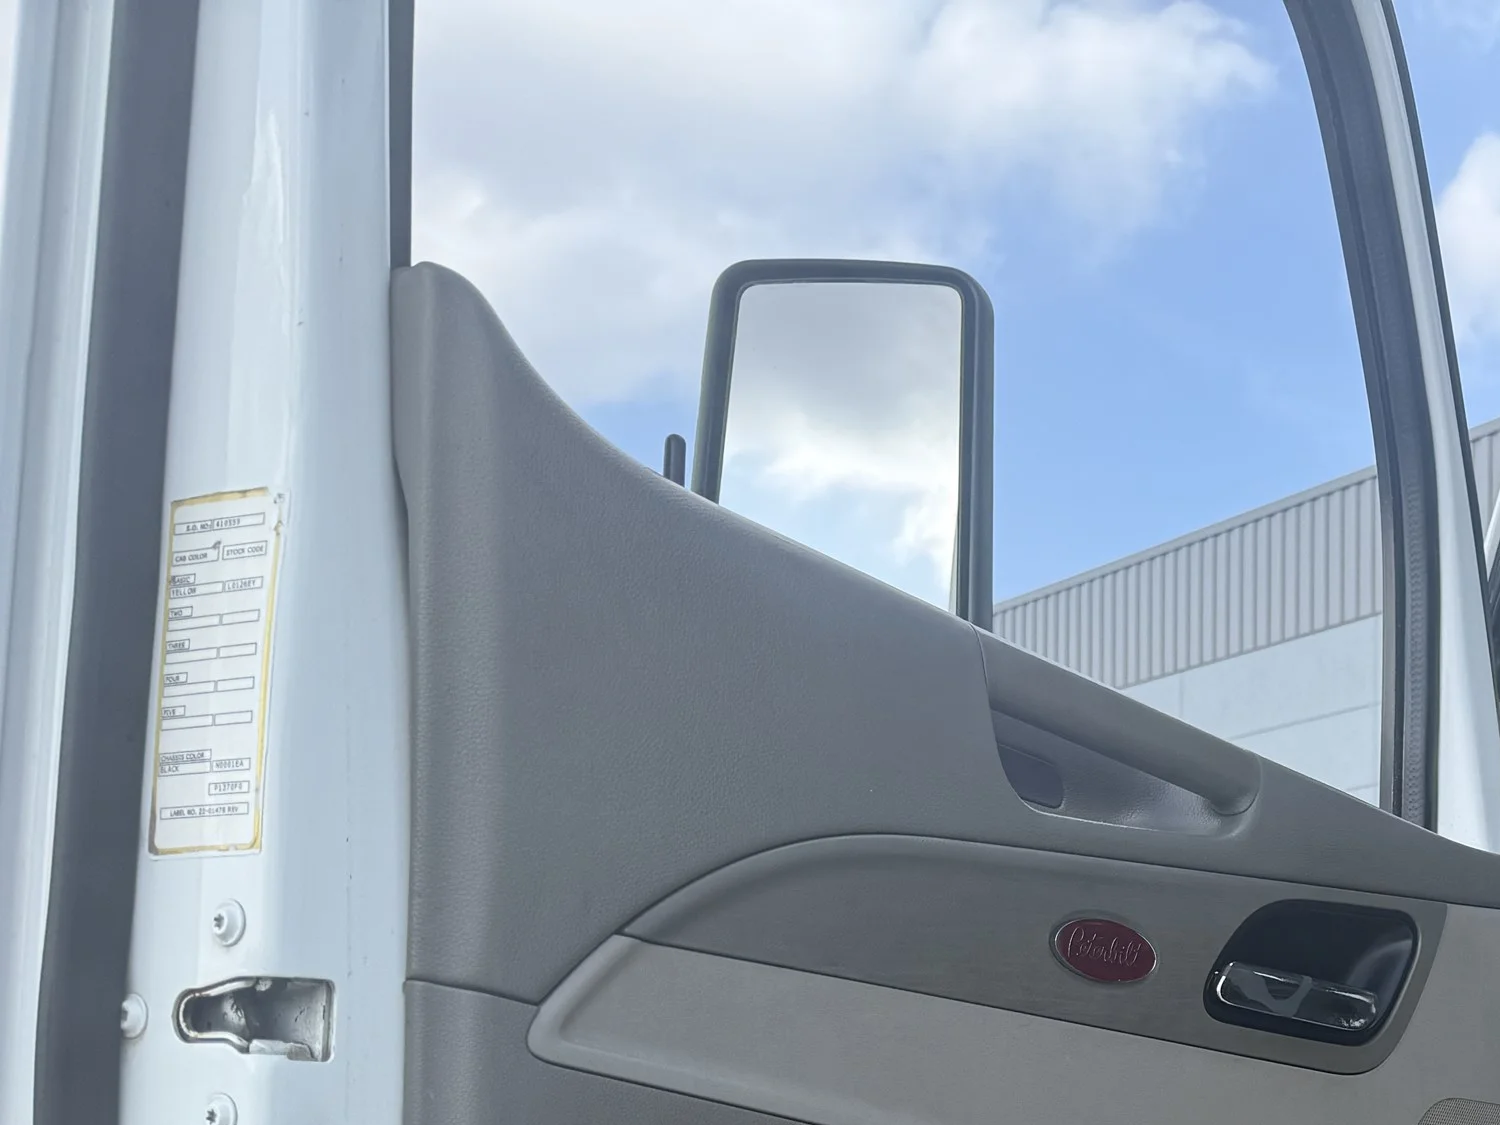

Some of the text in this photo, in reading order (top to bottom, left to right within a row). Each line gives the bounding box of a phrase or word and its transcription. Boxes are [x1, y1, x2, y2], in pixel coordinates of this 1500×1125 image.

[226, 545, 264, 557] STOCK CODE
[175, 553, 208, 563] CAB COLOR
[172, 588, 196, 597] YELLOW
[163, 708, 176, 716] FIVE
[160, 752, 205, 763] CHASSIS COLOR
[160, 766, 180, 774] BLACK
[1067, 926, 1142, 966] Peterbilt
